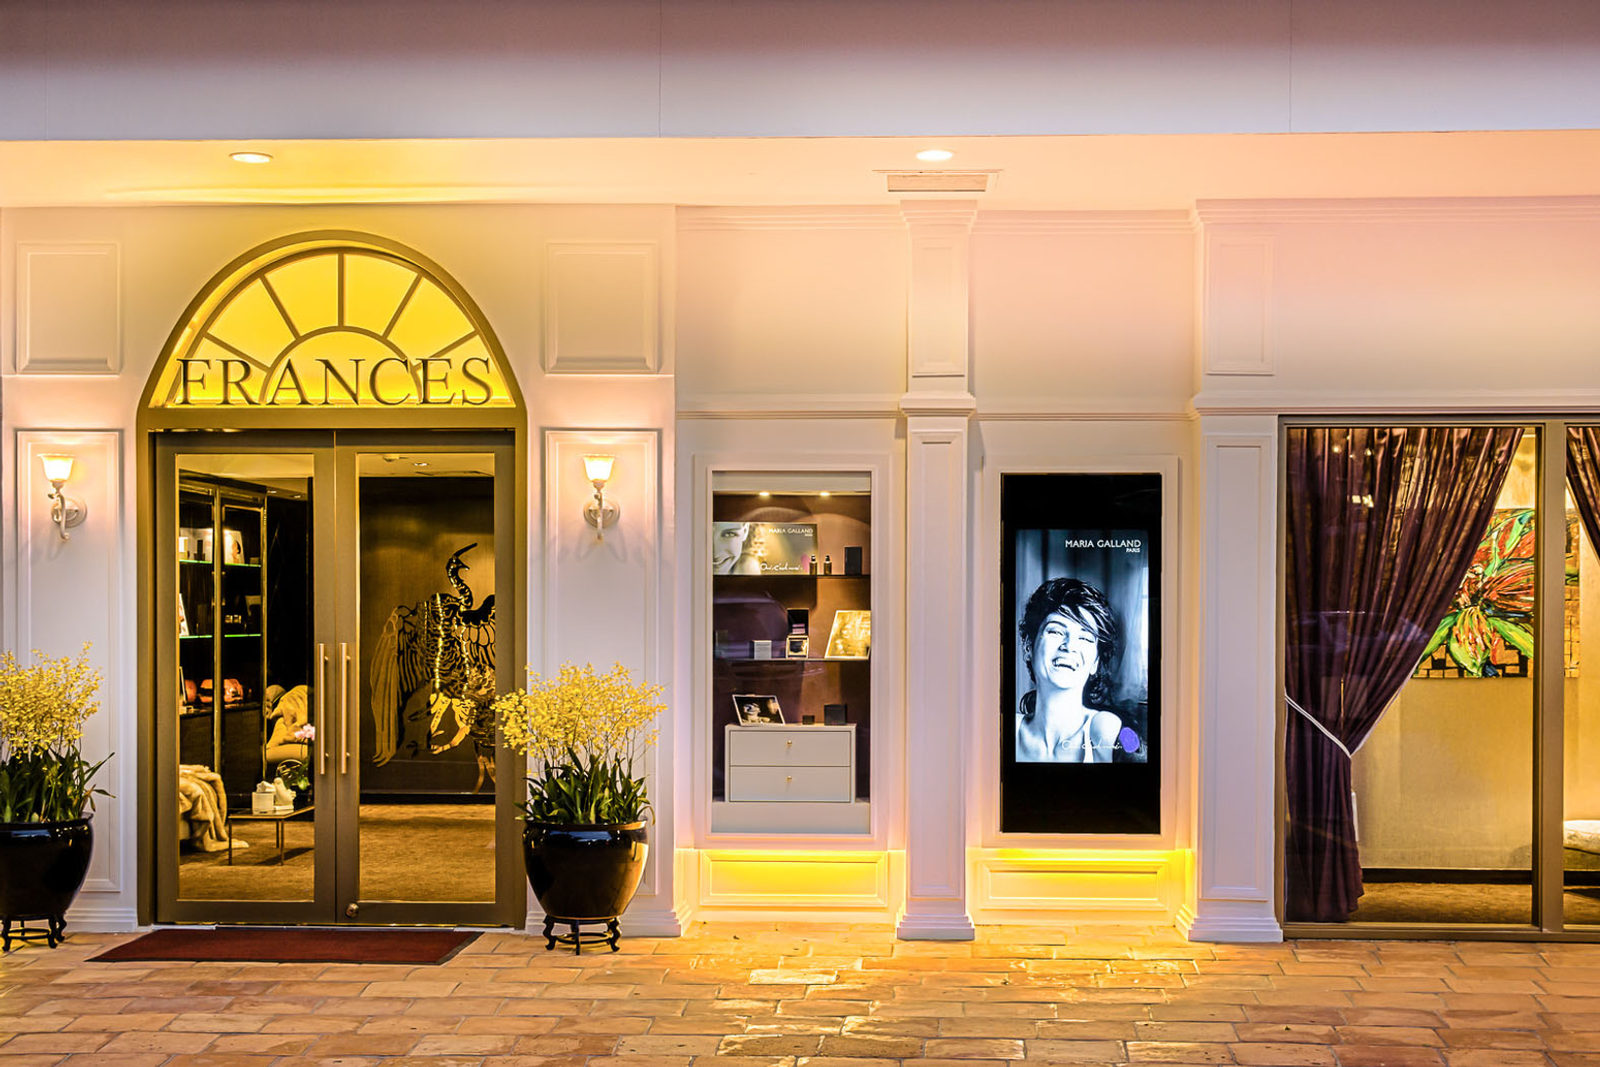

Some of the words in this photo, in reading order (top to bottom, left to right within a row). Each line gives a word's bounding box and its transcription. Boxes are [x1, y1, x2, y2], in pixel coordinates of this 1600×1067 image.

[176, 357, 494, 406] FRANCES
[1065, 539, 1094, 548] MARIA
[1096, 539, 1142, 548] GALLAND
